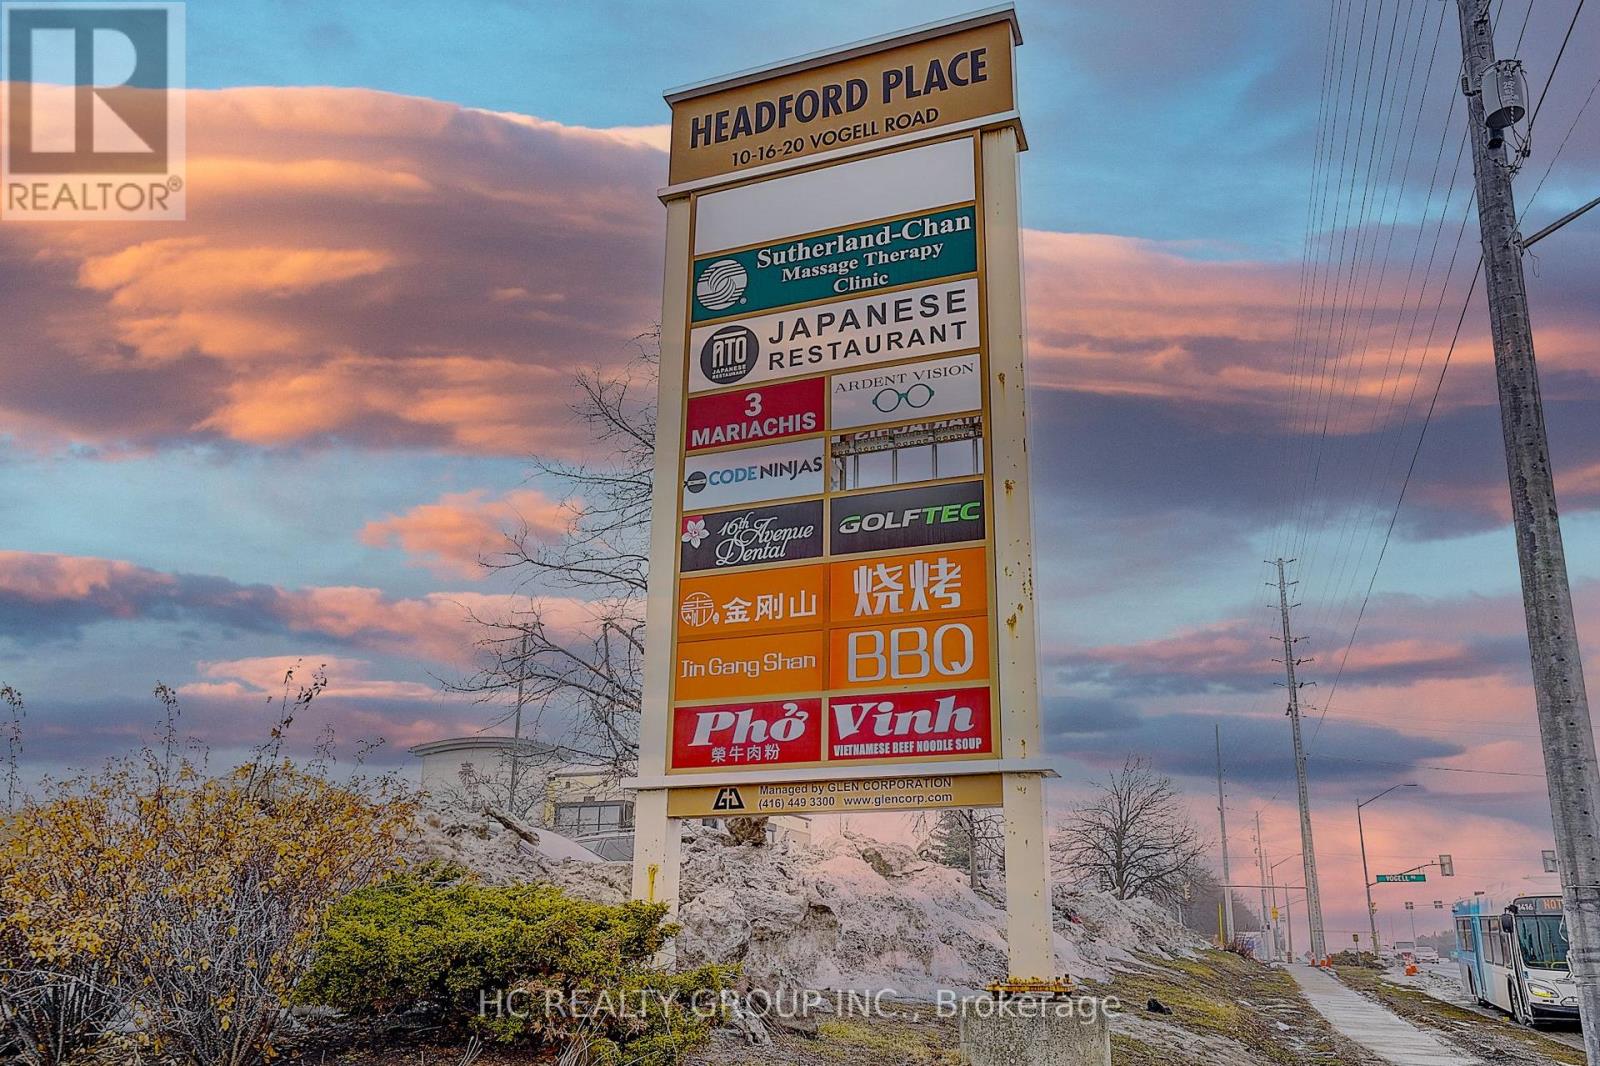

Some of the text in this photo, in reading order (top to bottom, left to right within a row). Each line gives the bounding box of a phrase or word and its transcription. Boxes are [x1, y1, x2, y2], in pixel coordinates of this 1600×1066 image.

[690, 47, 988, 149] HEADFORD PLACE
[731, 107, 939, 167] 10-16-20 VOGELL ROAD
[756, 214, 971, 269] Sutherland-Chan
[782, 242, 944, 283] Massage Therapy
[833, 272, 889, 294] Clinic
[768, 289, 967, 345] JAPANESE
[712, 330, 747, 368] ATO
[768, 321, 967, 371] RESTAURANT
[712, 364, 747, 375] JAPANESE
[834, 362, 974, 394] ARDENT VISION
[744, 393, 763, 417] 3
[691, 412, 817, 447] MARIACHIS
[717, 511, 814, 546] 16th Avenue
[839, 502, 981, 535] GOLFTEC
[715, 538, 788, 566] Dental
[853, 557, 962, 617] 烧烤
[722, 590, 817, 624] 金刚山
[681, 652, 816, 678] Jin Gang Shan
[848, 623, 974, 682] BBQ
[831, 695, 975, 741] Vinh
[711, 743, 780, 763] 榮牛肉粉
[833, 737, 983, 757] VIETNAMESE BEEF NOODLE SOUP
[758, 793, 953, 809] (416) 449 3300 www.glencorp.com
[759, 777, 952, 796] Managed by GLEN CORPORATION
